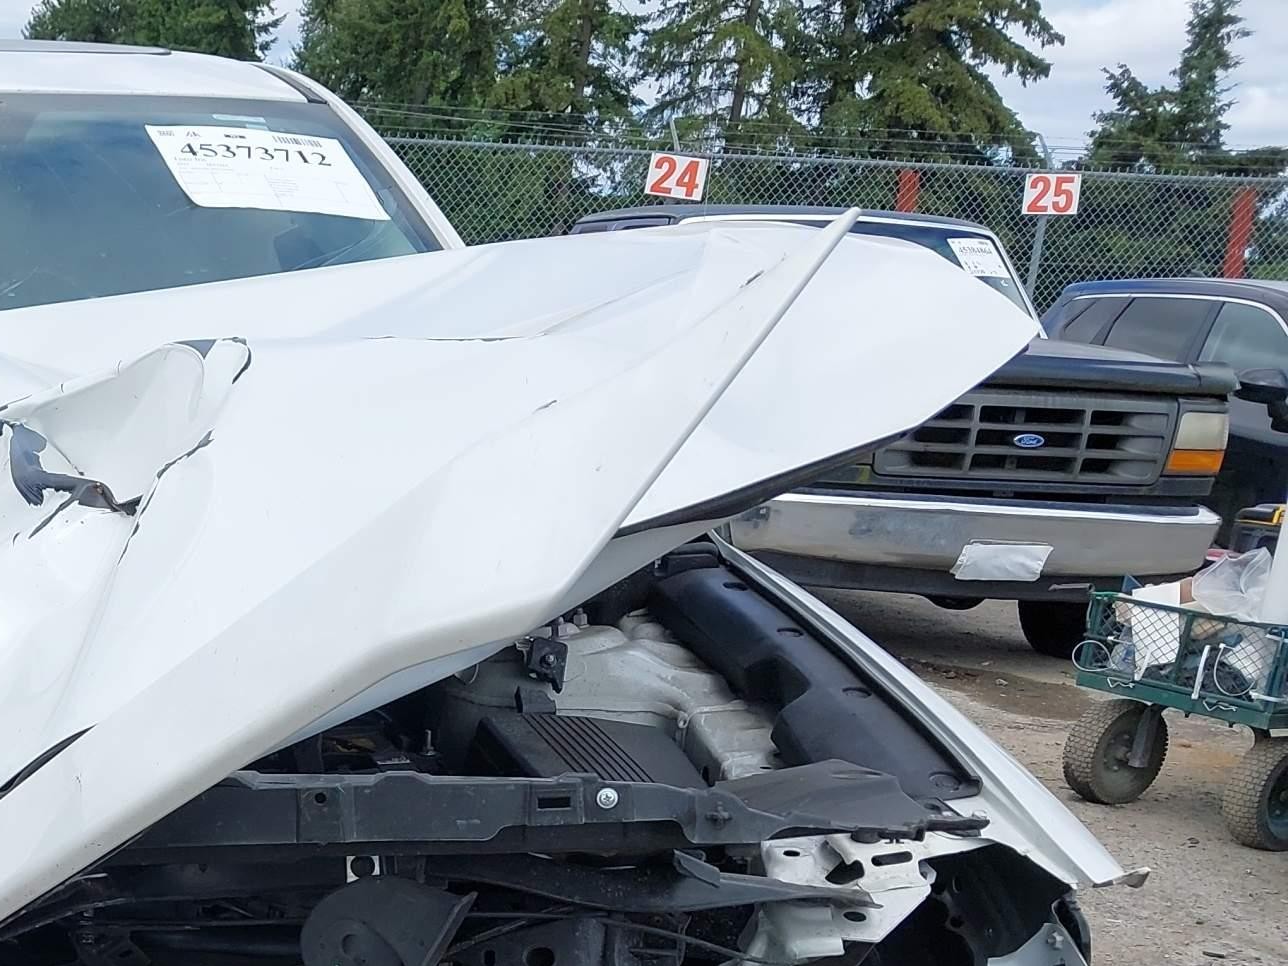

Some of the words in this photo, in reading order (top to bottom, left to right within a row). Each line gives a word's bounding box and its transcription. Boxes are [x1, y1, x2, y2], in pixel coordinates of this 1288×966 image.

[180, 142, 332, 167] 45373712
[649, 155, 700, 198] 24
[1026, 175, 1076, 213] 25
